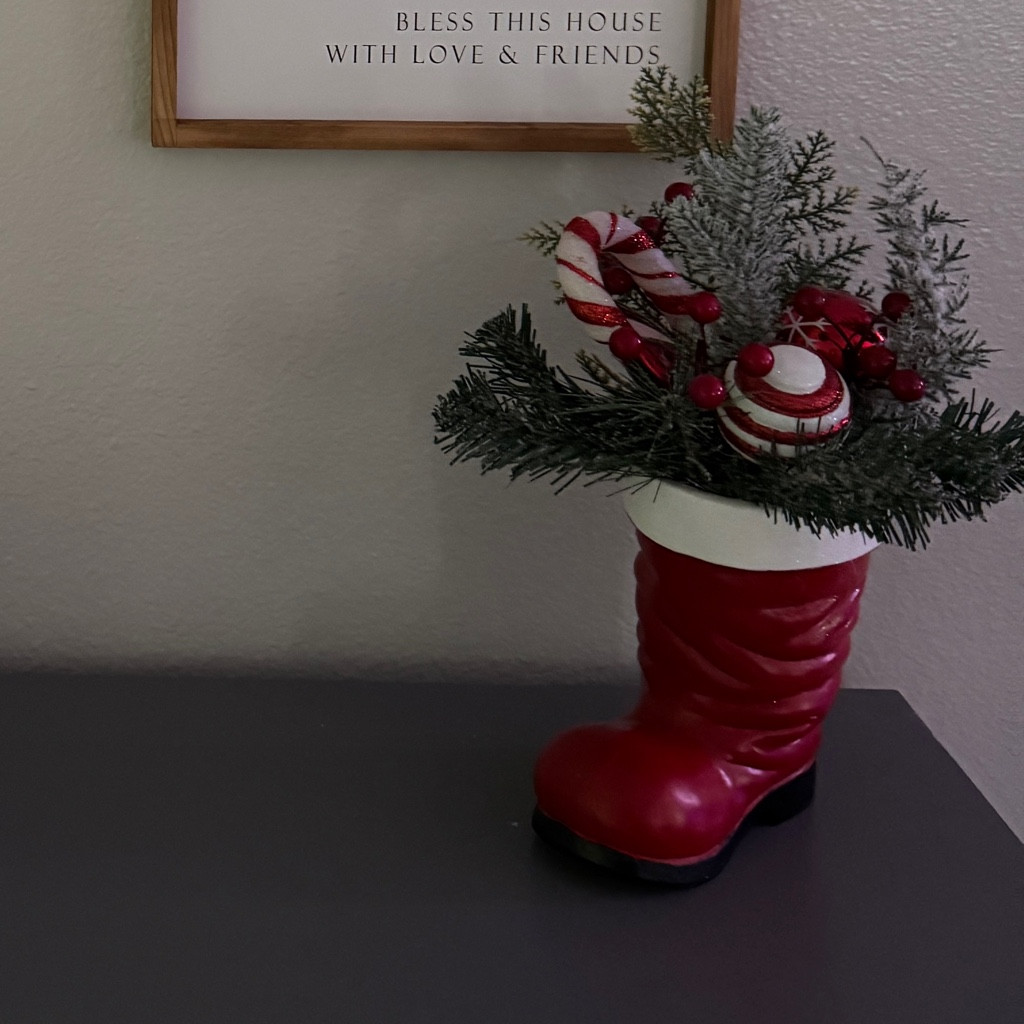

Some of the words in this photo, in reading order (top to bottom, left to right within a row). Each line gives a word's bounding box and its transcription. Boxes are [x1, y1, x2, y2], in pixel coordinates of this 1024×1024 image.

[396, 11, 474, 32] BLESS
[488, 11, 551, 32] THIS
[566, 11, 662, 32] HOUSE
[325, 44, 397, 64] WITH
[412, 44, 484, 65] LOVE
[498, 44, 519, 65] &
[535, 44, 661, 65] FRIENDS
